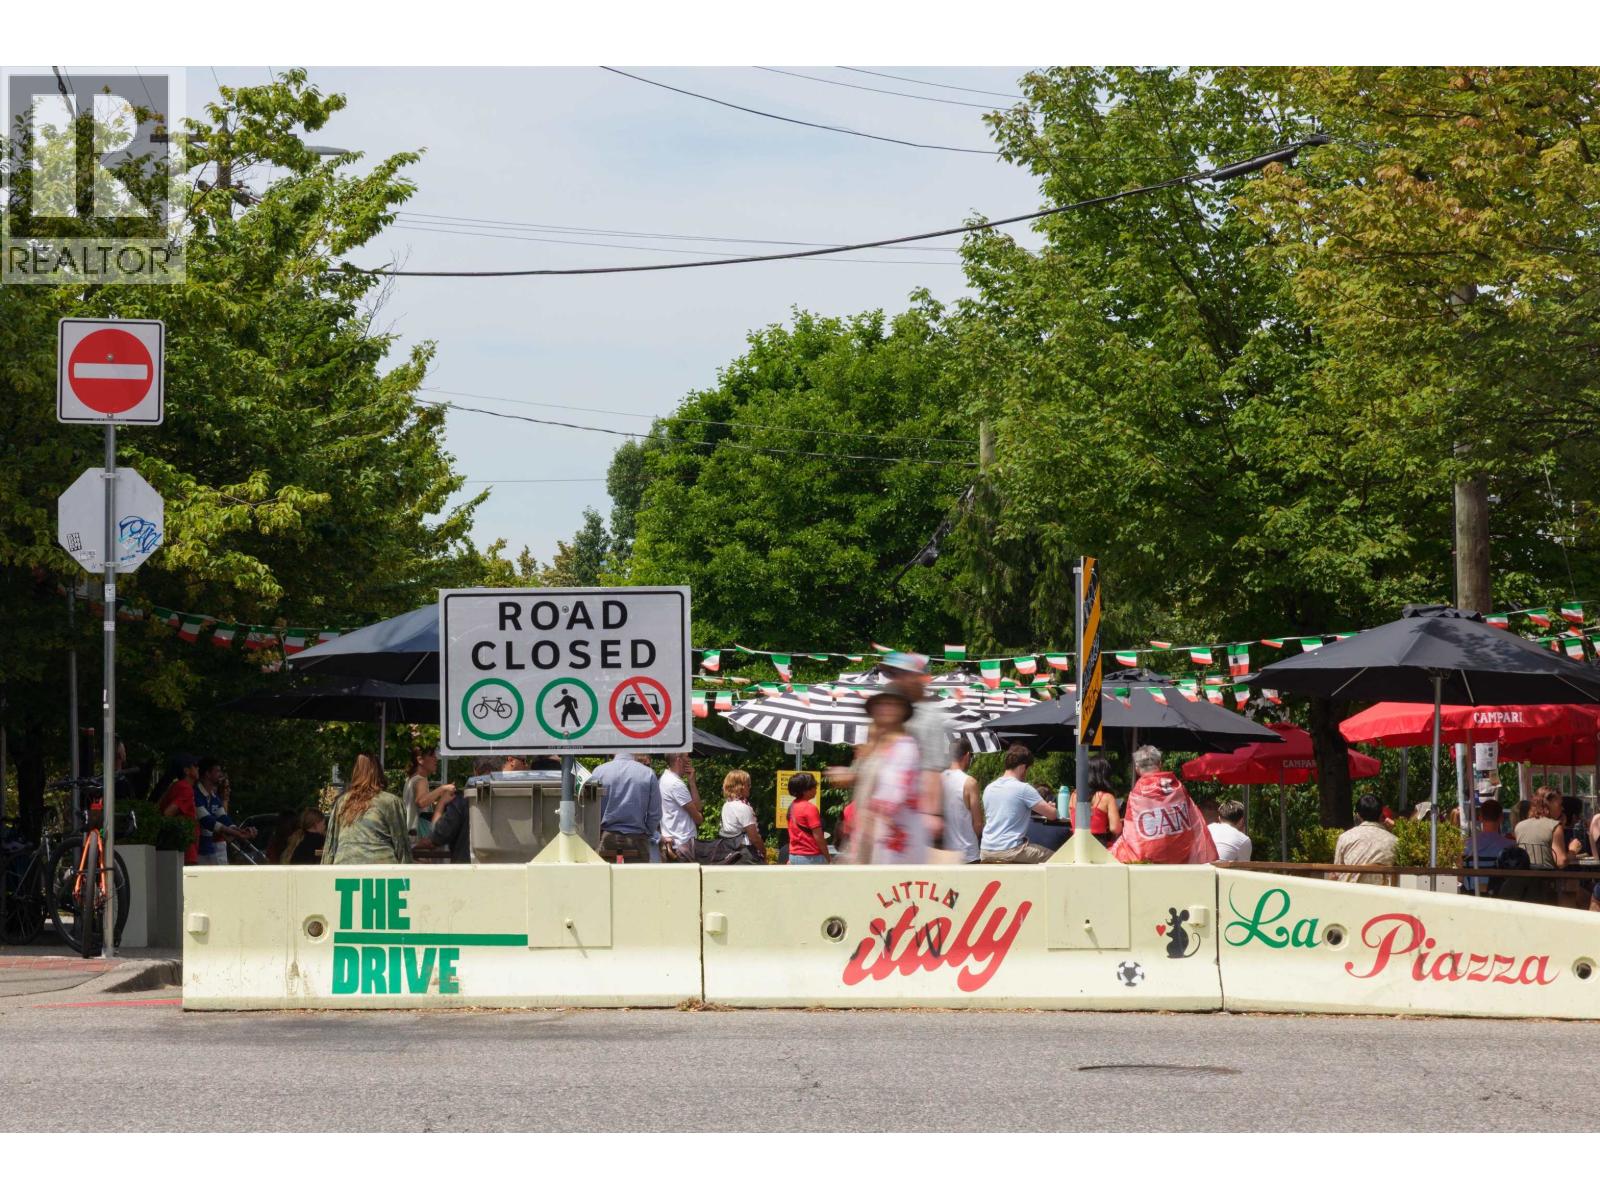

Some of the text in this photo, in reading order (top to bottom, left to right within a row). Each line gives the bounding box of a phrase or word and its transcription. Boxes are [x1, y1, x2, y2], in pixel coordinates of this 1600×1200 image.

[498, 600, 628, 631] ROAD
[471, 639, 656, 670] CLOSED
[1473, 711, 1523, 724] CAMPARI
[1282, 759, 1317, 768] CAMPAR
[335, 878, 410, 930] THE
[876, 881, 959, 909] LITTLE
[842, 880, 1033, 992] italy
[1224, 881, 1562, 986] La Piazza
[332, 946, 459, 994] DRIVE
